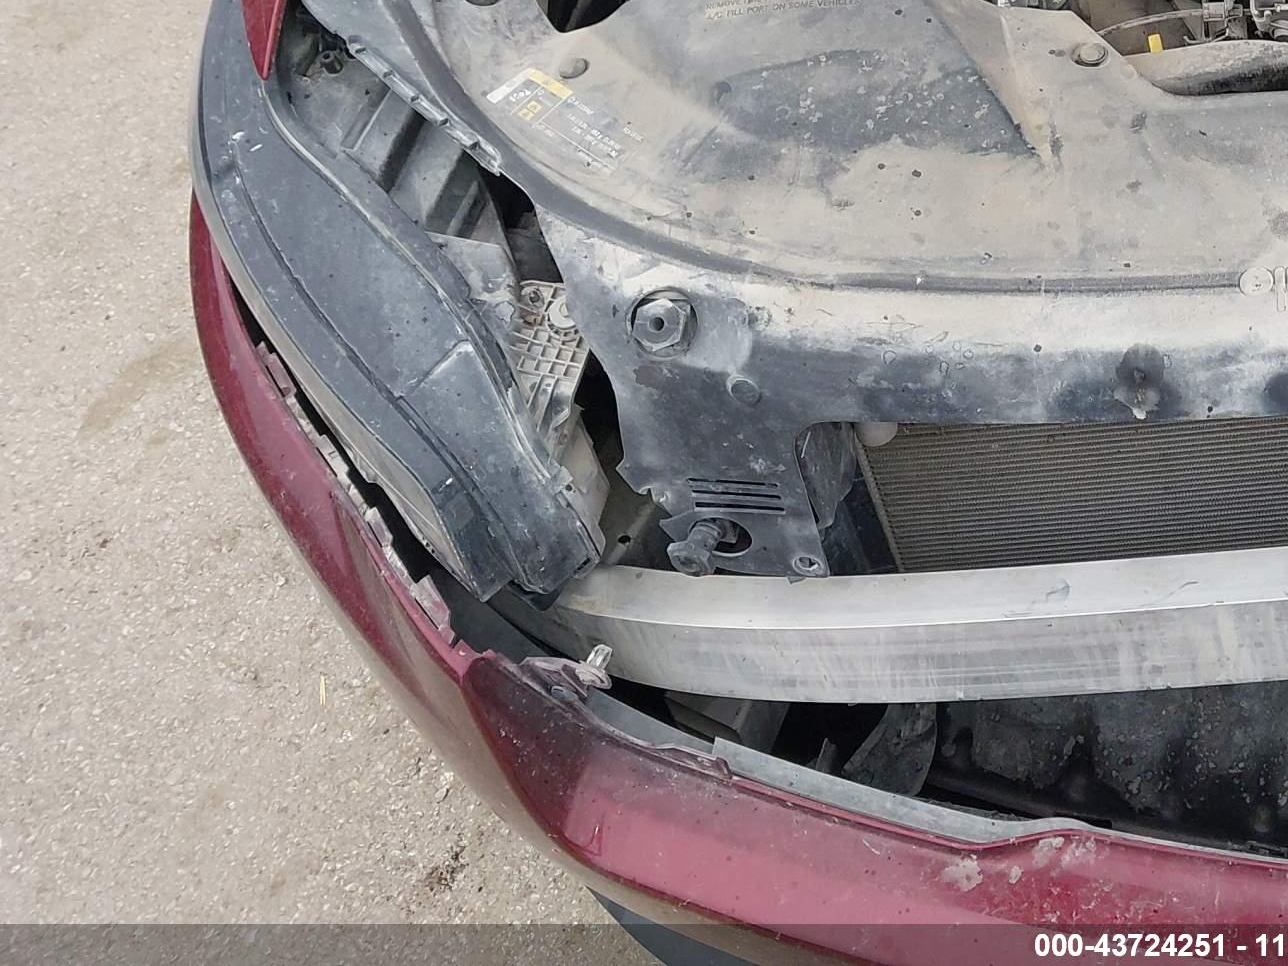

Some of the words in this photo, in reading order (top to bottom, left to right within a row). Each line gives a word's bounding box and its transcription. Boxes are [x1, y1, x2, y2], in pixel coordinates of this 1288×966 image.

[726, 6, 744, 17] FILL
[747, 5, 769, 15] PORT
[773, 2, 786, 11] ON
[788, 0, 814, 10] SOME
